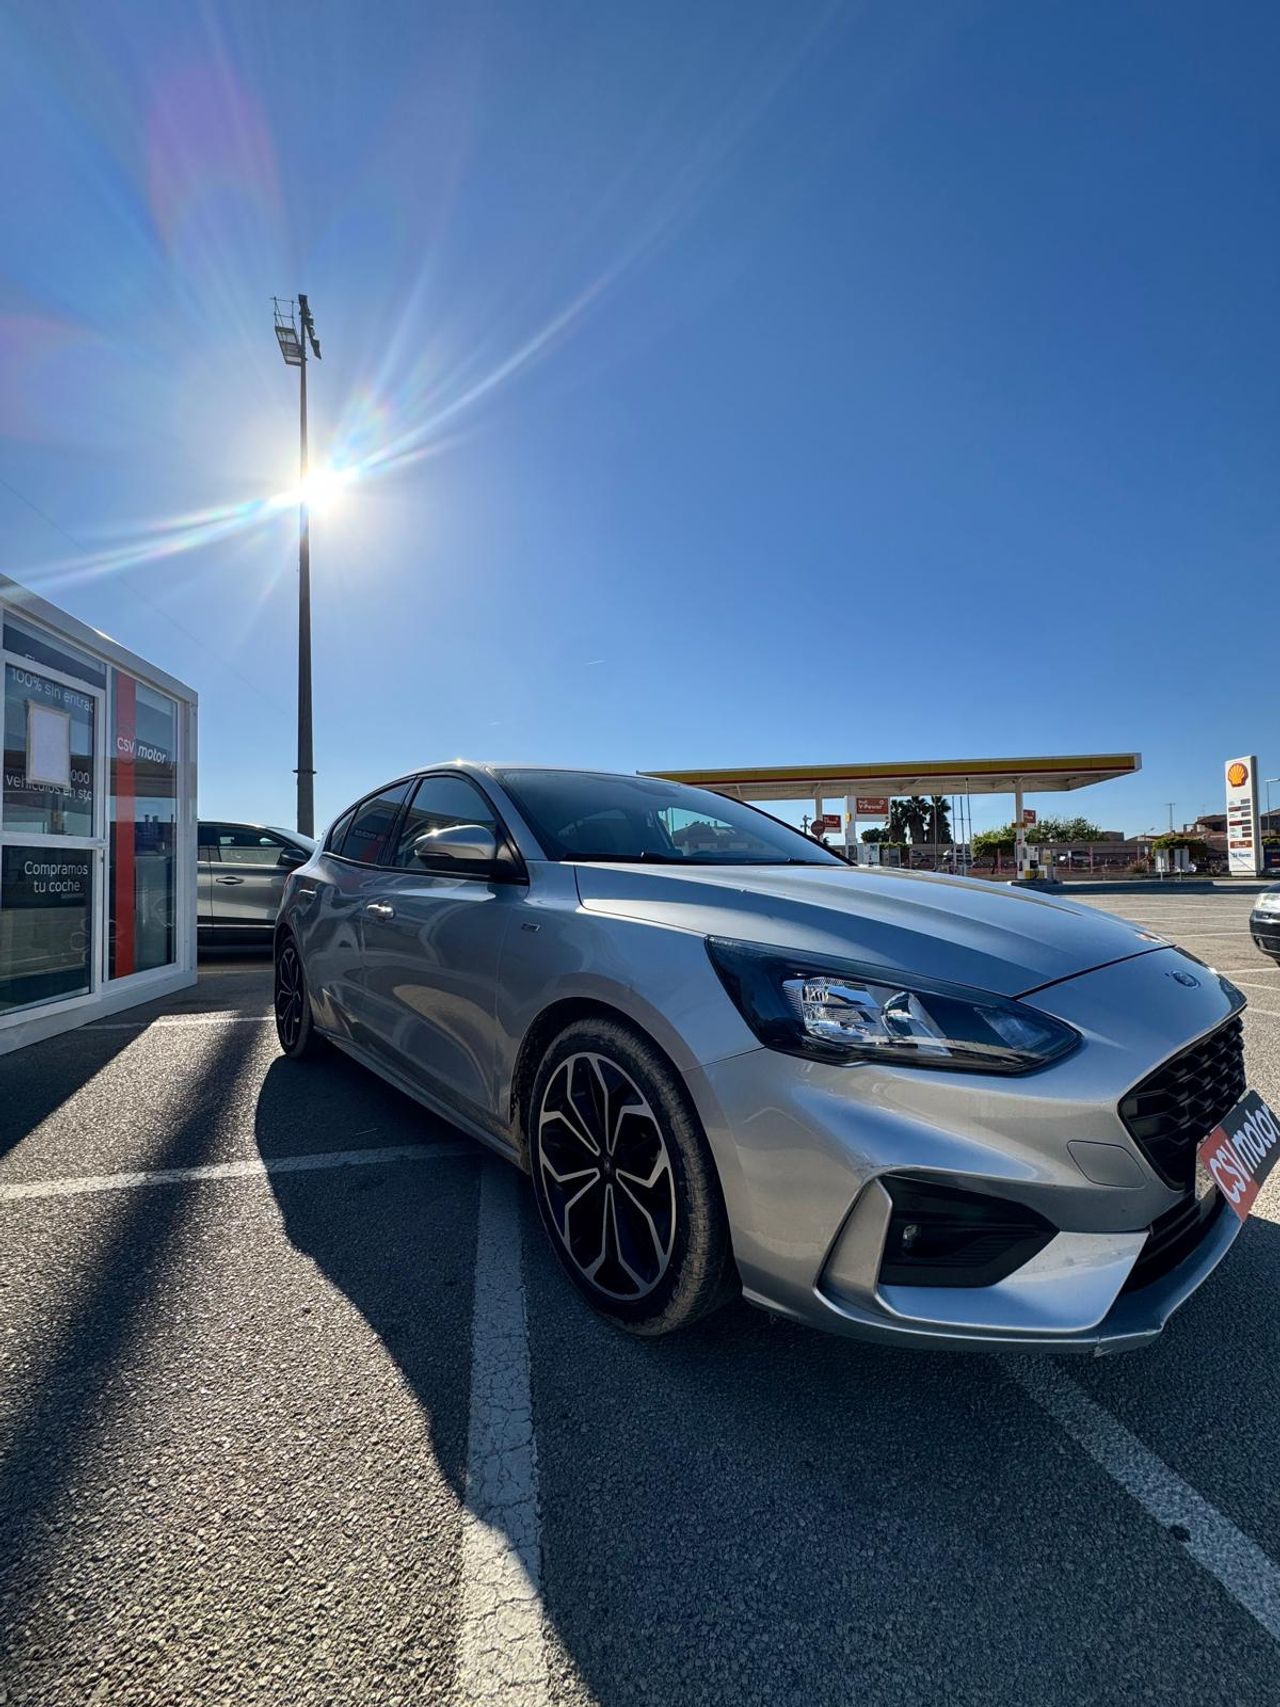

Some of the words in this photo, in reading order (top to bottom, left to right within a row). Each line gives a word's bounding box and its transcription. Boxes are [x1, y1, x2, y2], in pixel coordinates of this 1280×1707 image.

[11, 668, 42, 693] 100%
[45, 683, 61, 700] sin
[138, 745, 167, 763] motor
[24, 861, 88, 876] Compramos
[34, 880, 46, 893] tu
[49, 879, 80, 892] coche
